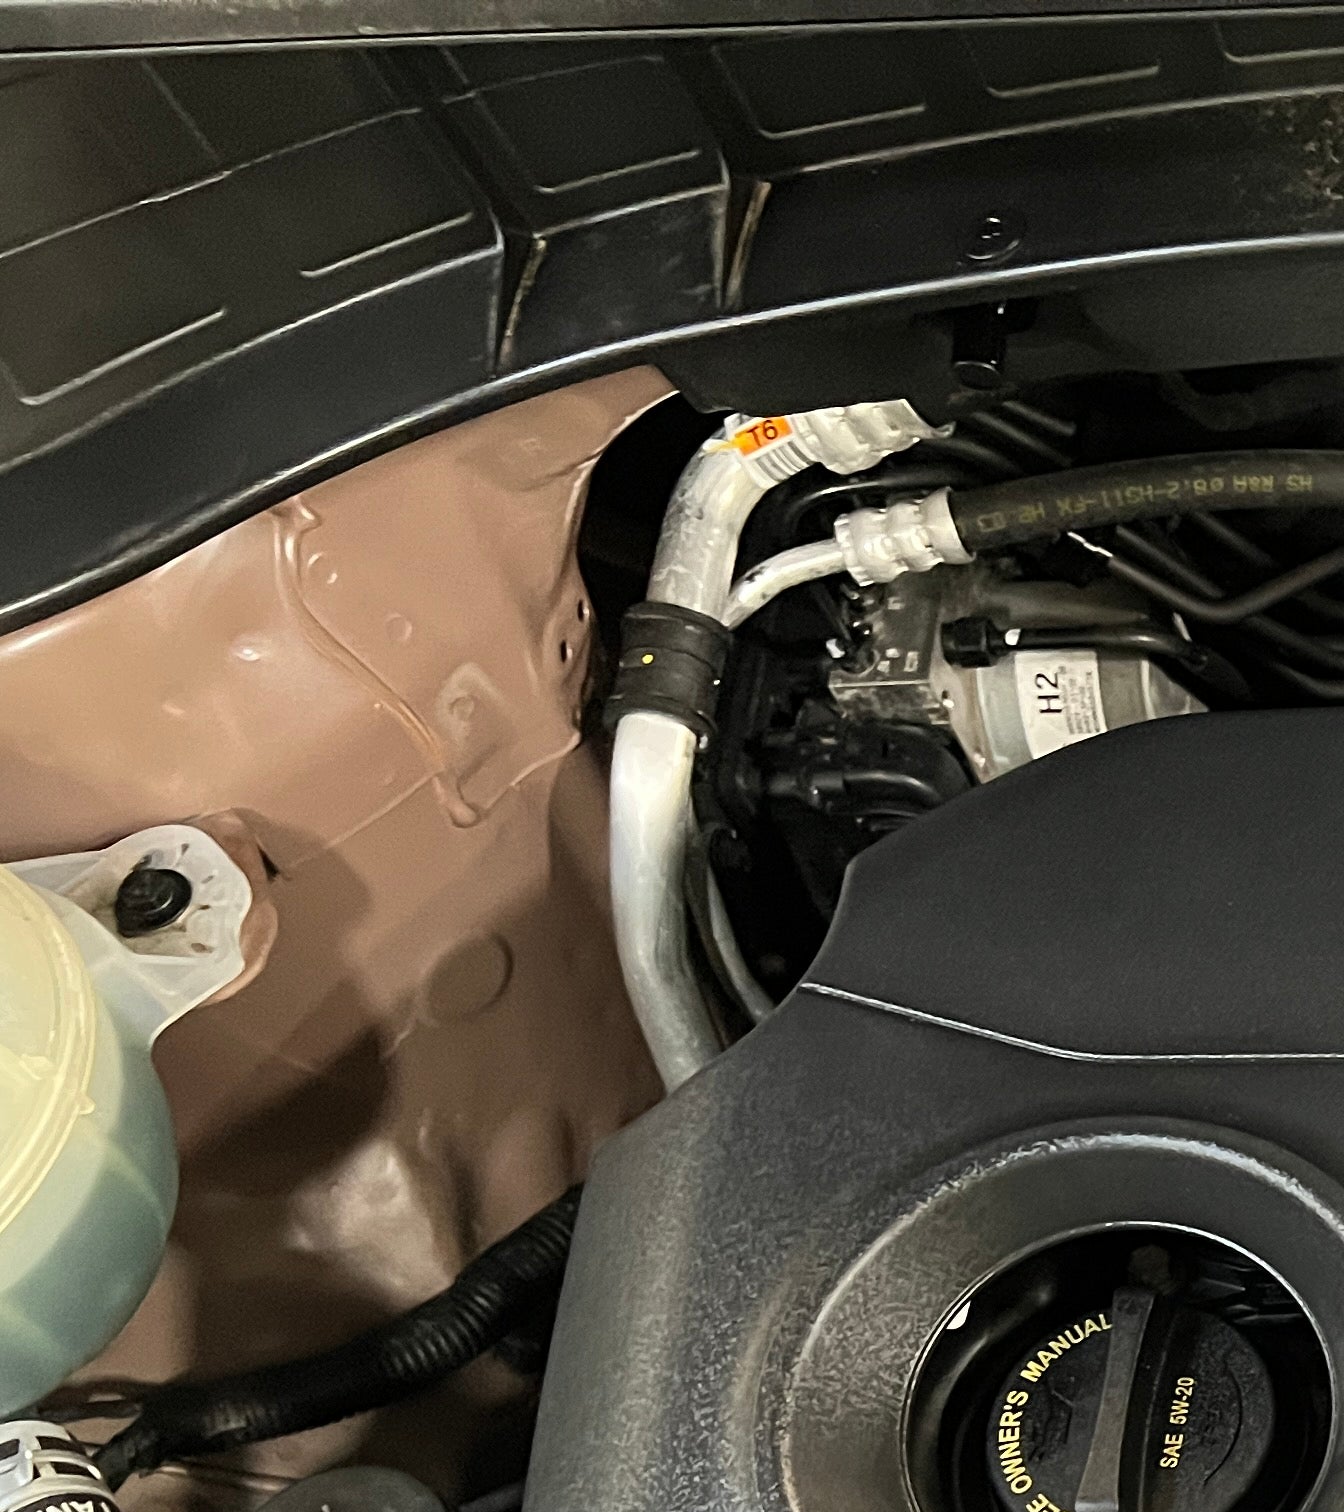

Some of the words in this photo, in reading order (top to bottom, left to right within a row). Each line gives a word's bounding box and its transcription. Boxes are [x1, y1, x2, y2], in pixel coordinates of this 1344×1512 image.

[744, 419, 780, 449] T6
[1037, 671, 1062, 715] H2
[997, 1390, 1034, 1495] OWNER'S
[1019, 1313, 1114, 1384] MANUAL
[1169, 1376, 1195, 1426] 5W-20
[1159, 1432, 1184, 1469] SAE
